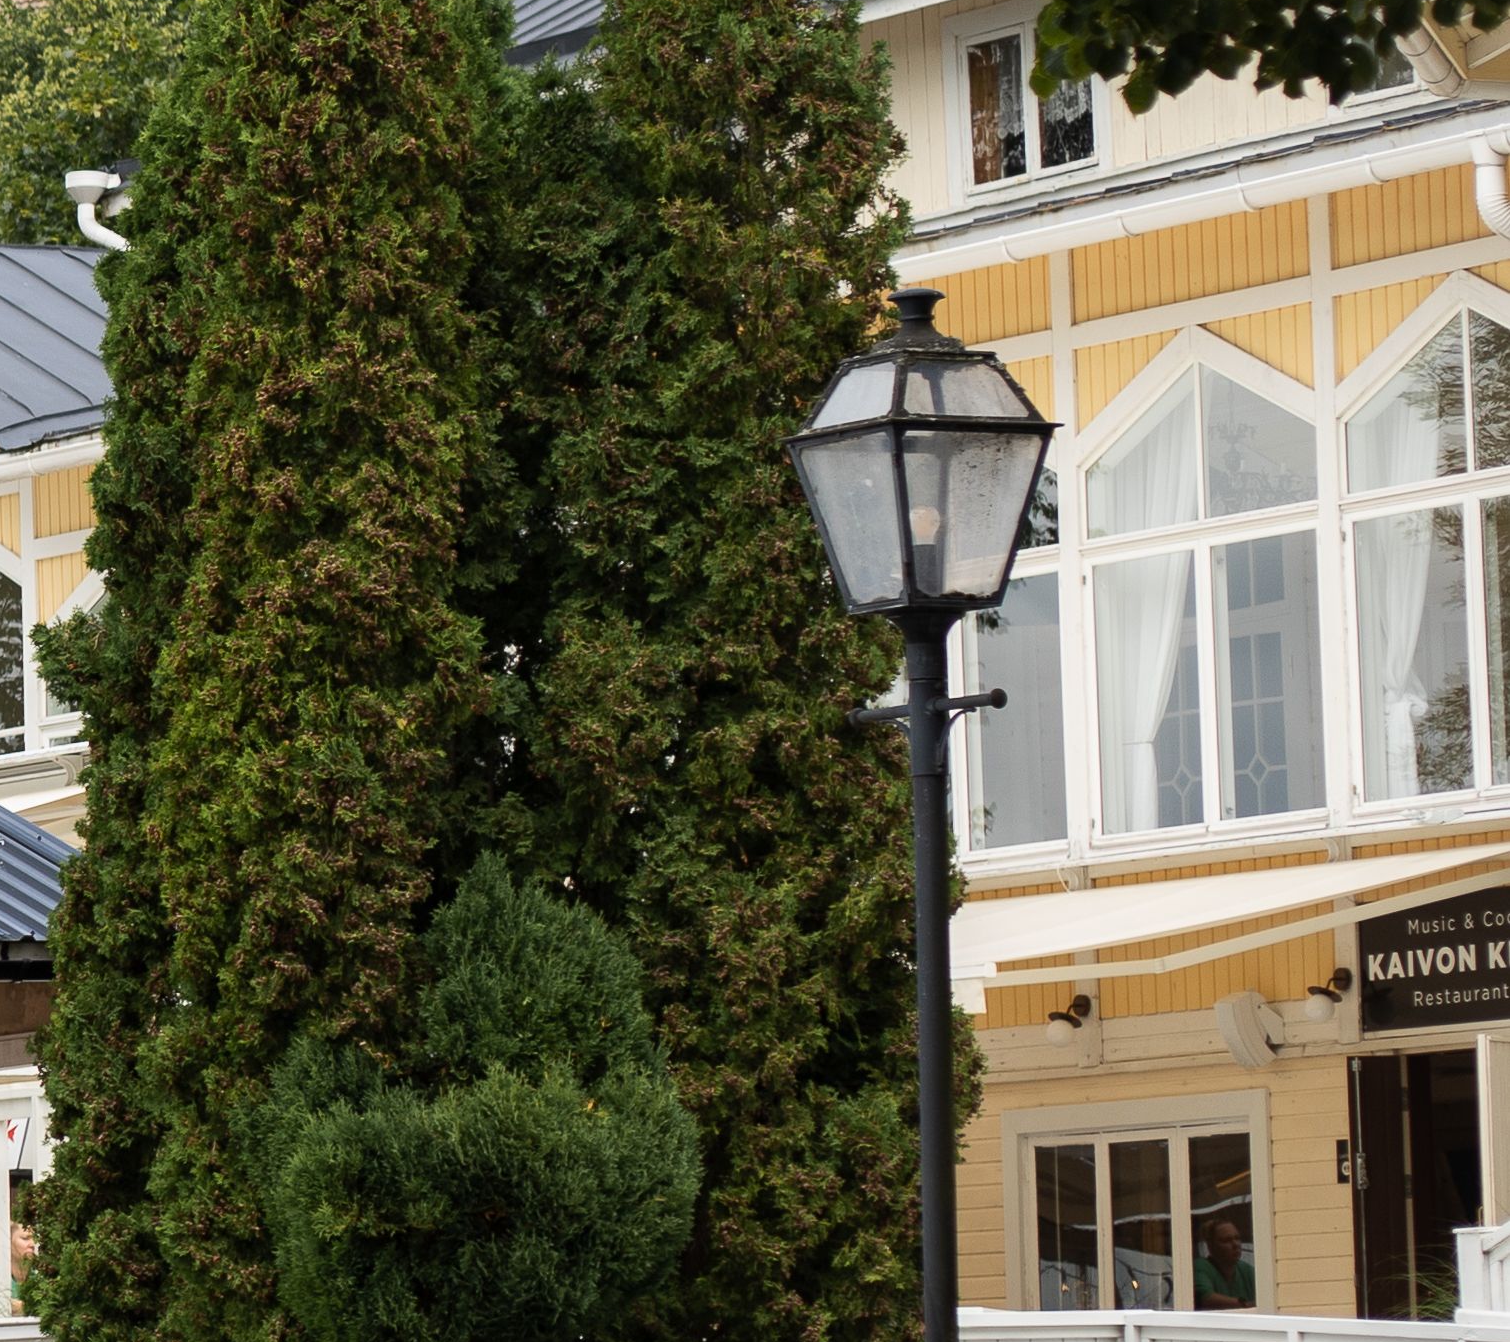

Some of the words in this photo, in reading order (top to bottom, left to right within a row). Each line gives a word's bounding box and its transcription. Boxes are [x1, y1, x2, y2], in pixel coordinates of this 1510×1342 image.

[1407, 916, 1456, 935] Music
[1464, 913, 1475, 929] &
[1368, 944, 1477, 981] KAIVON
[1414, 983, 1510, 1007] Restaurant
